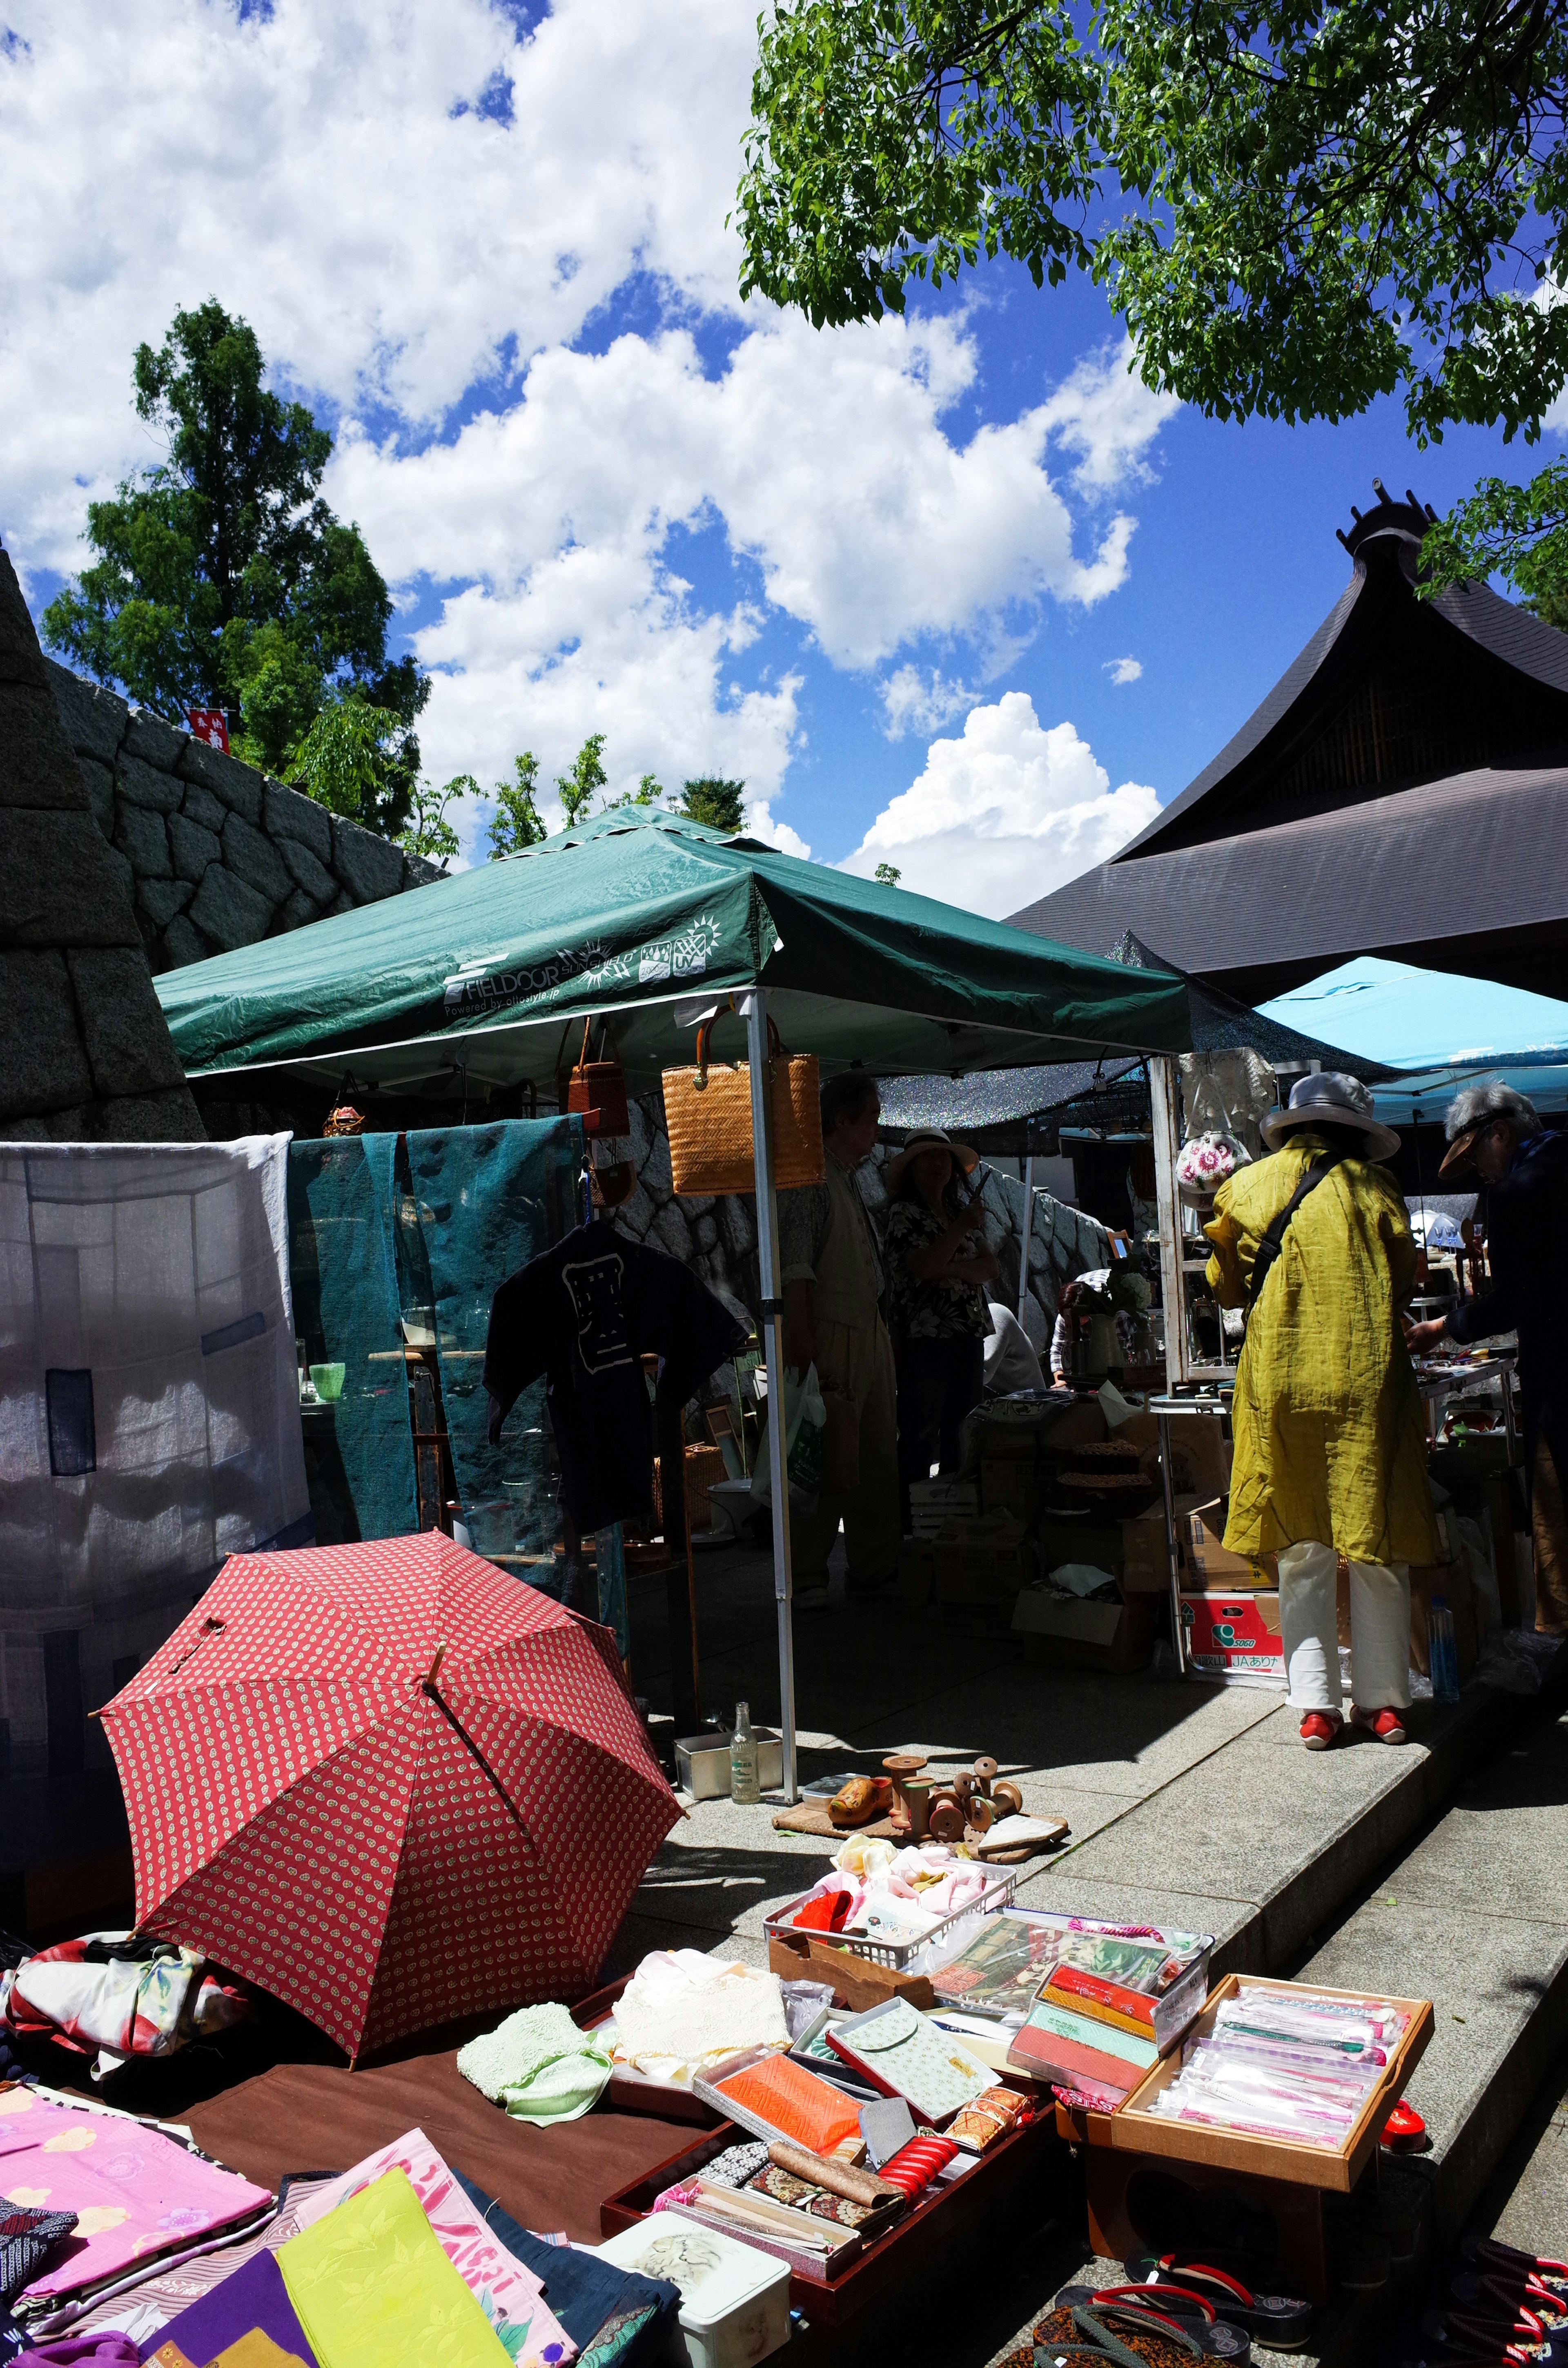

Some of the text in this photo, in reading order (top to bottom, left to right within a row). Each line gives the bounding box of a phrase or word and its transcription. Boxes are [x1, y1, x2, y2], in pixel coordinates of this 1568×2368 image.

[561, 961, 588, 975] SUN
[675, 953, 695, 969] UV
[466, 966, 560, 1000] FIELDOOR
[444, 987, 560, 1016] Powered by ottostyle.jp
